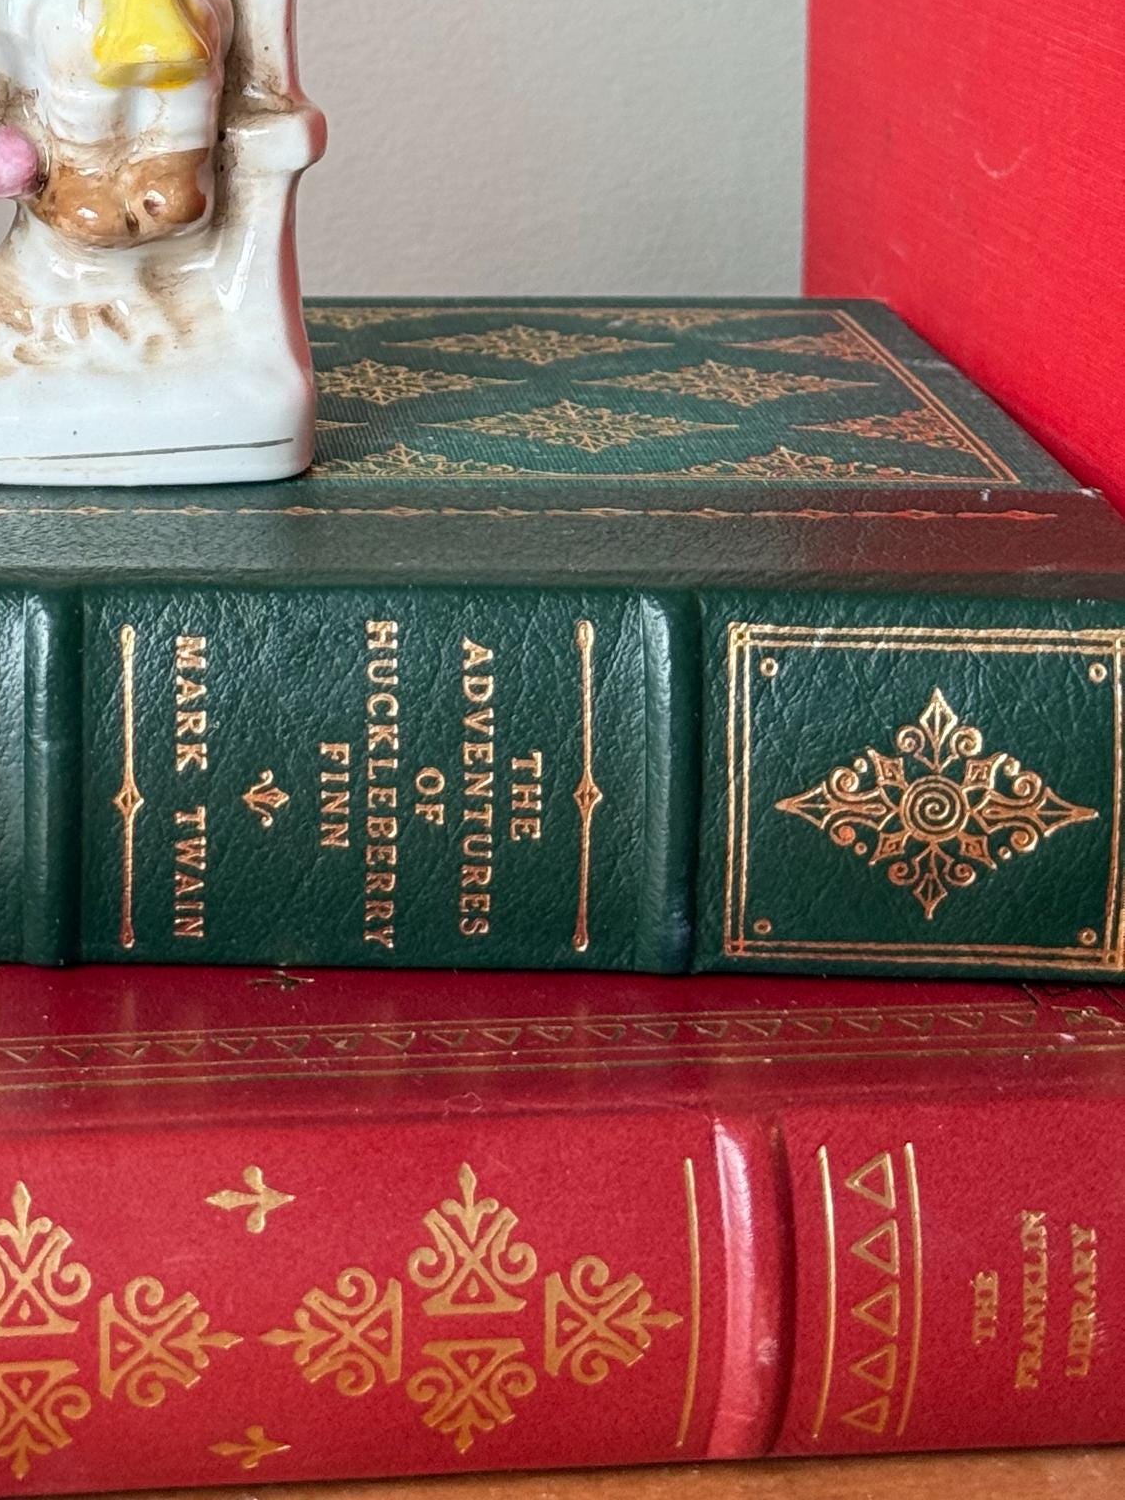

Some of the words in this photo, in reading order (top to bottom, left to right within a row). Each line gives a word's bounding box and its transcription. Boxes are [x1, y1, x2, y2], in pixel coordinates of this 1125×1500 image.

[175, 636, 208, 771] MARK
[319, 741, 350, 849] FINN
[363, 619, 400, 949] HUCKLEBERRY
[415, 766, 446, 825] OF
[459, 636, 494, 937] ADVENTURES
[509, 750, 543, 841] THE
[174, 805, 206, 939] TWAIN
[972, 1271, 999, 1344] THE
[1015, 1209, 1048, 1389] FRANKLIN
[1065, 1222, 1097, 1376] LIBRARY
